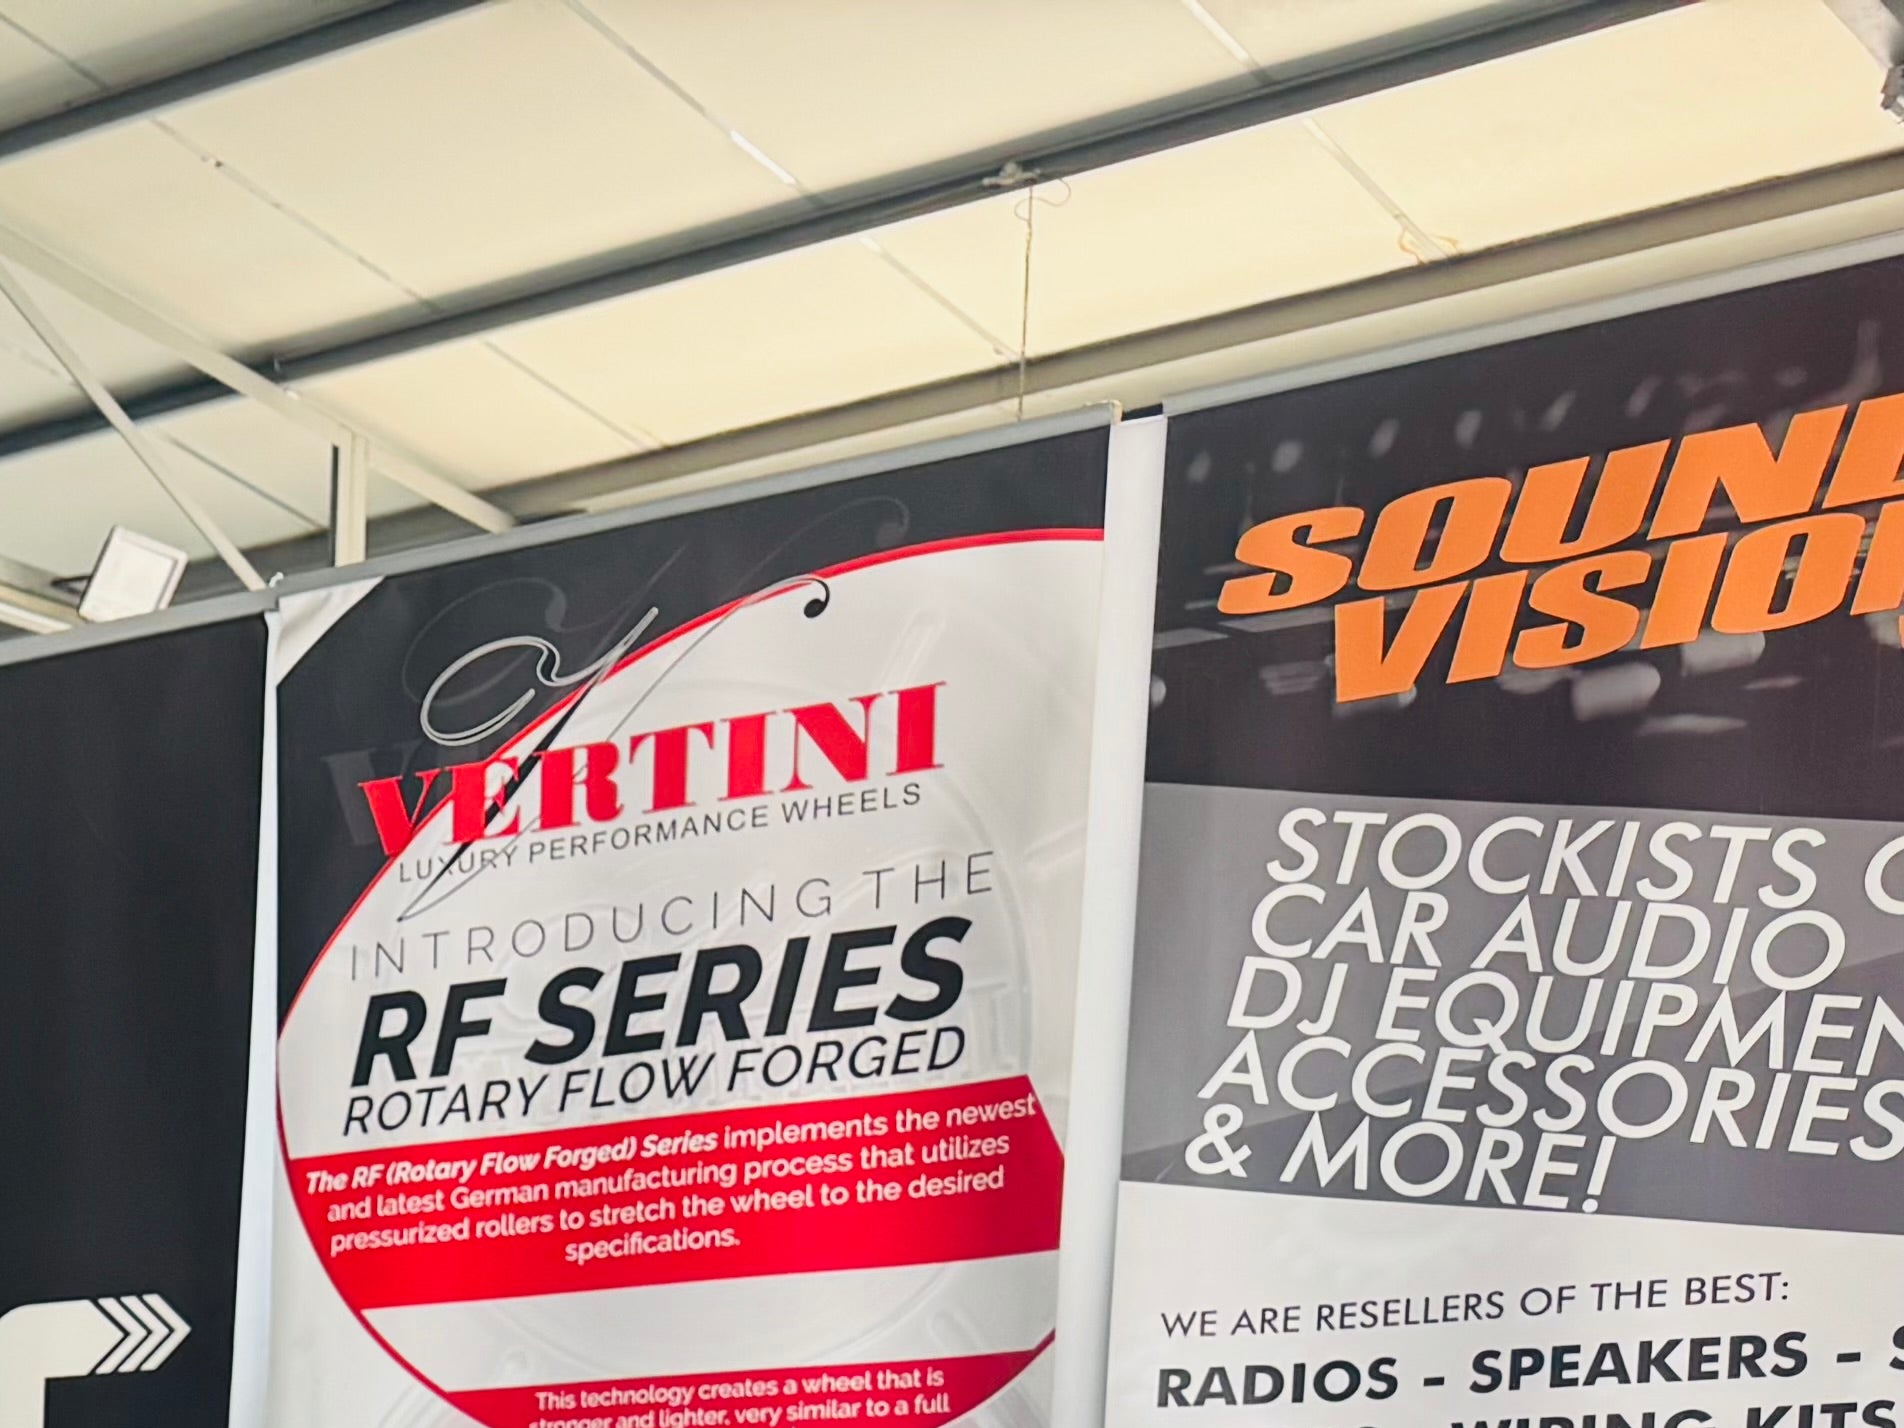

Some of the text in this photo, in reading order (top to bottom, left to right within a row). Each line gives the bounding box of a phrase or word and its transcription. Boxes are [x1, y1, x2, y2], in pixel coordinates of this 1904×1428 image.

[358, 682, 948, 857] VERTINI
[398, 781, 924, 883] LUXURY PERFORMANCE WHEELS
[1265, 808, 1826, 908] STOCKISTS
[351, 850, 995, 983] INTRODUCING THE
[1251, 884, 1845, 991] CAR AUDIO
[351, 916, 972, 1087] RF SERIES
[1226, 956, 1348, 1032] DJ
[343, 1026, 965, 1136] ROTARY FLOW FORGED
[1197, 1032, 1904, 1162] ACCESSORIES
[307, 1095, 1037, 1194] The RF (Rotary Flow Forged) Series implements the newest
[328, 1136, 1009, 1222] and latest German manufacturing process that utilizes
[1184, 1103, 1616, 1213] & MORE!
[331, 1165, 1004, 1257] pressurized rollers to stretch the wheel to the desired
[566, 1227, 740, 1265] specifications.
[1161, 1272, 1788, 1337] WE ARE RESELLERS OF THE BEST:
[535, 1369, 921, 1410] This technology creates wheel that
[735, 1407, 782, 1426] very
[787, 1399, 861, 1421] similar
[914, 1393, 950, 1414] full
[1158, 1332, 1807, 1407] RADIOS SPEAKERS
